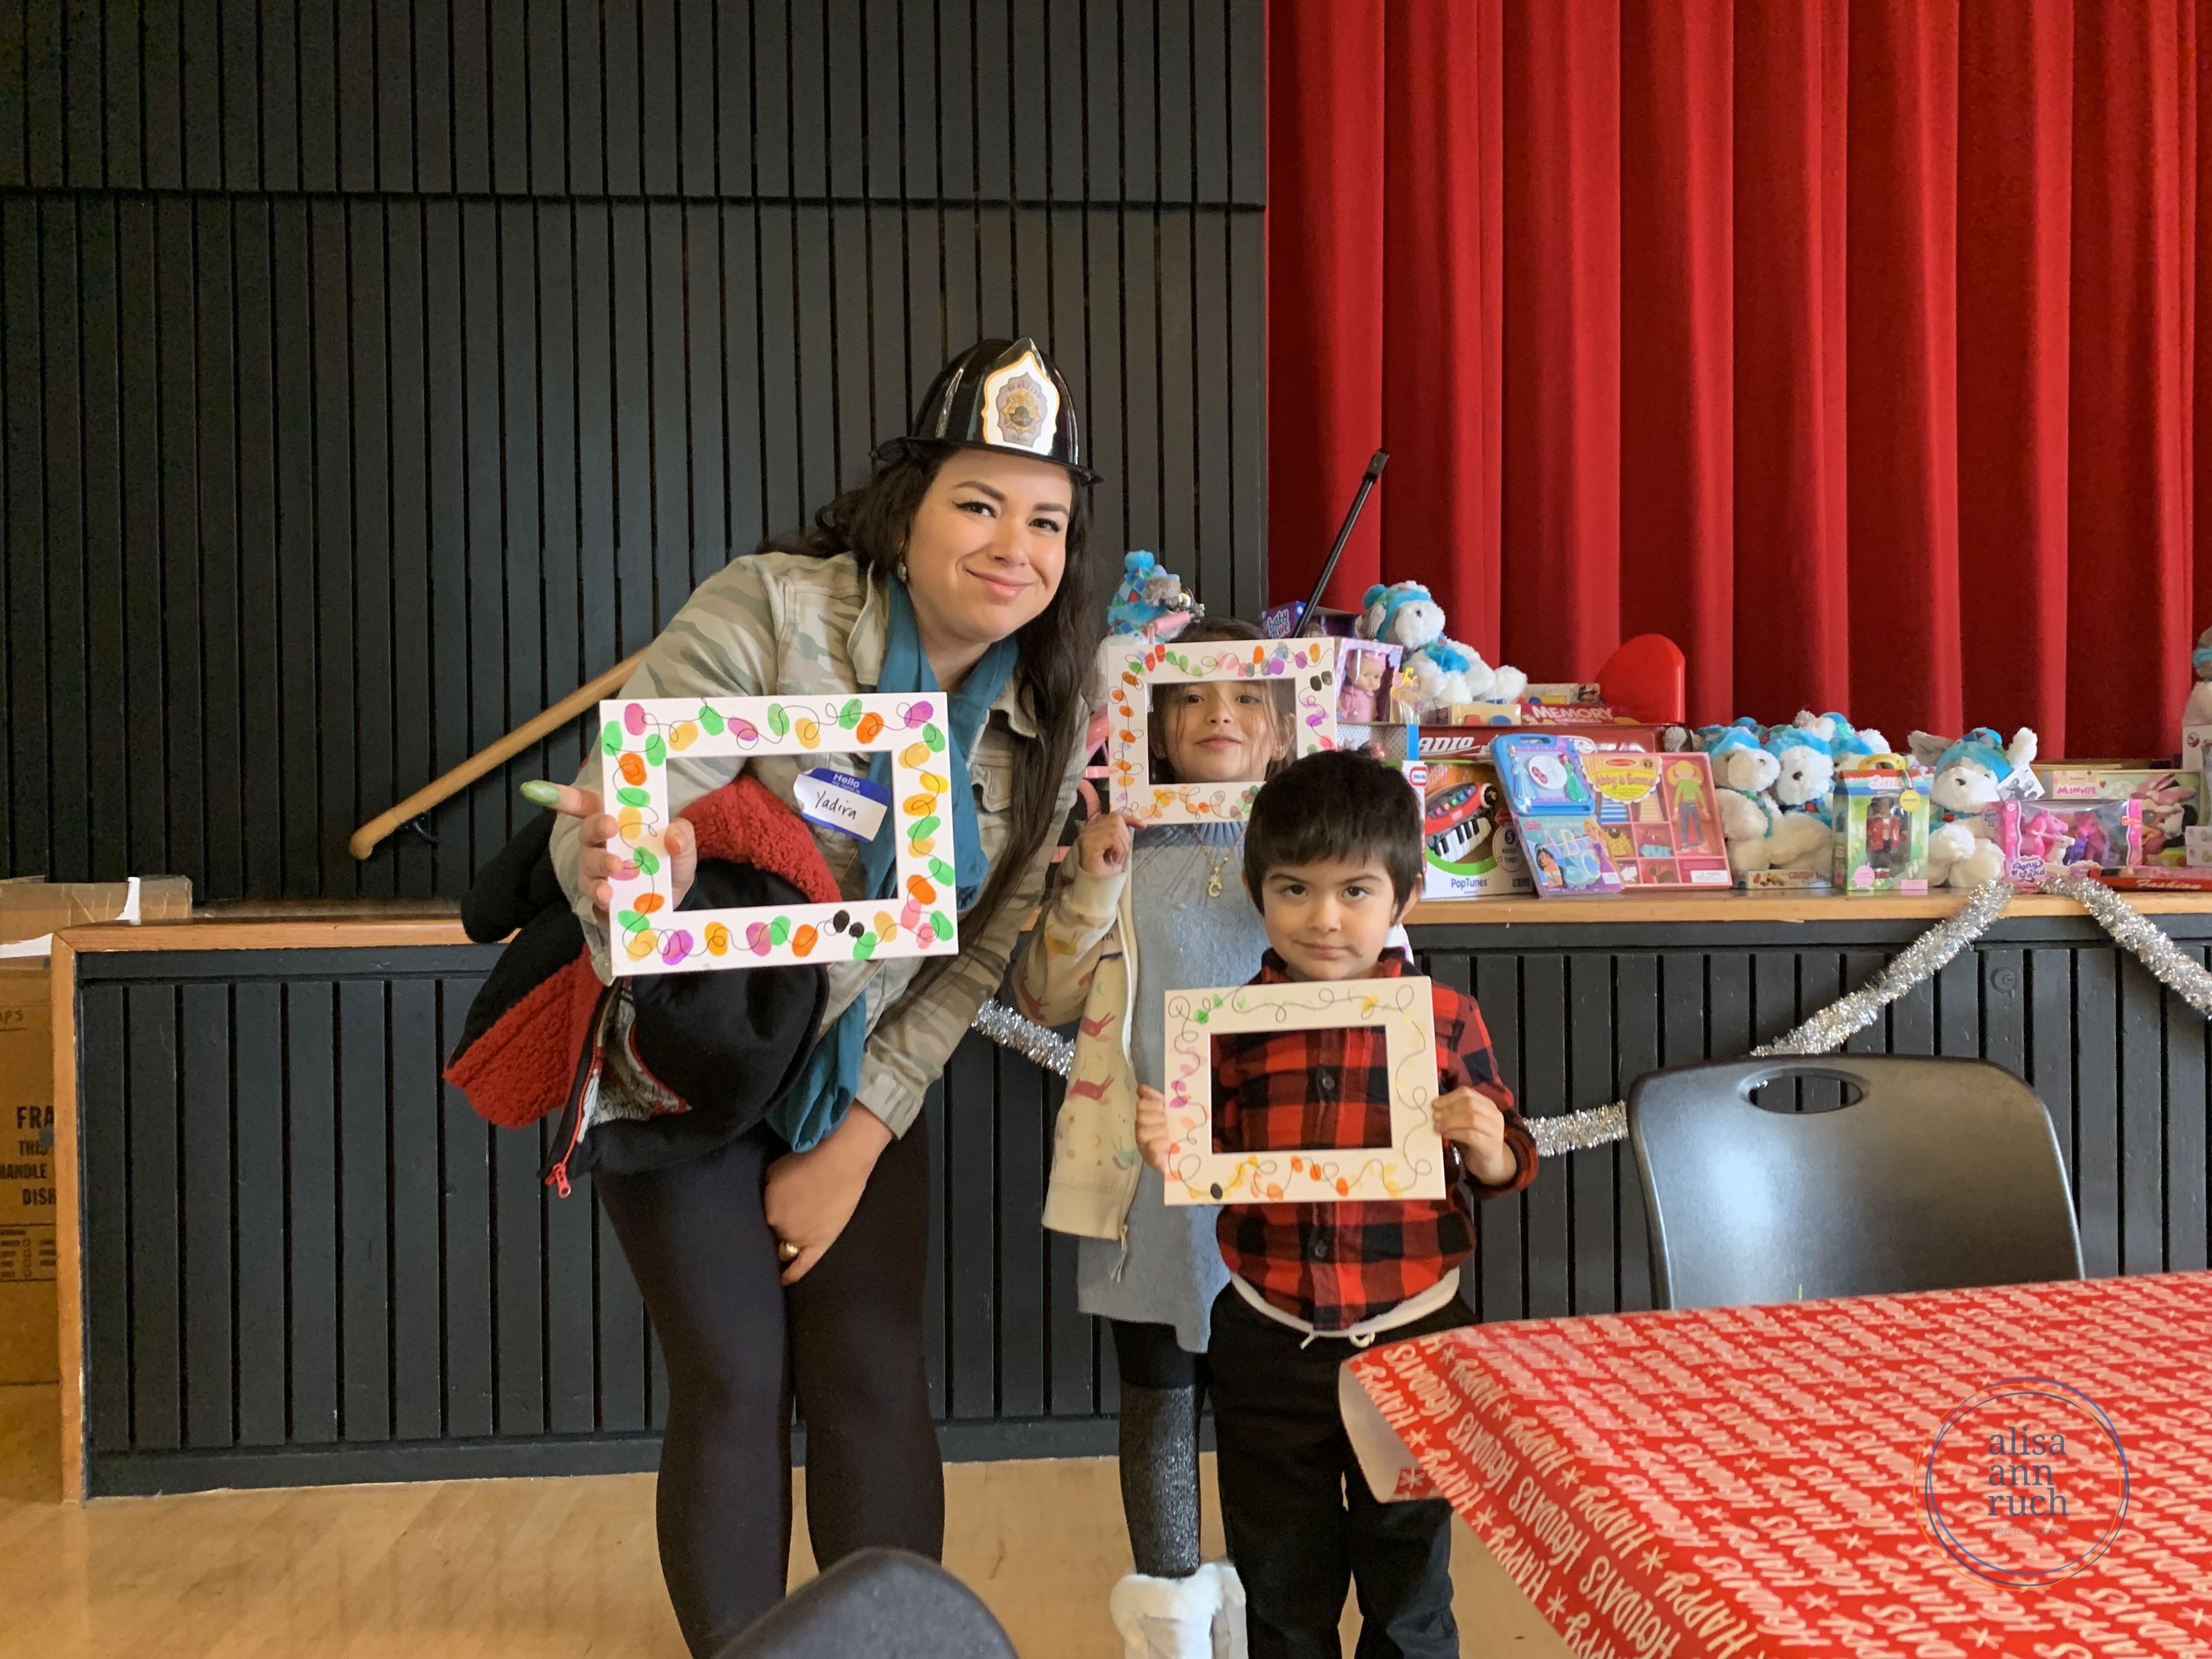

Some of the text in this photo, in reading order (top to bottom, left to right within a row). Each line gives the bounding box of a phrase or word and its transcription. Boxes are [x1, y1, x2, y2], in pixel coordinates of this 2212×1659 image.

[1267, 608, 1290, 632] baby
[1532, 705, 1613, 720] MEMORY
[834, 773, 860, 788] Hello
[815, 790, 857, 820] Yadira
[2012, 859, 2044, 872] Pony
[1451, 878, 1488, 890] PopTunes
